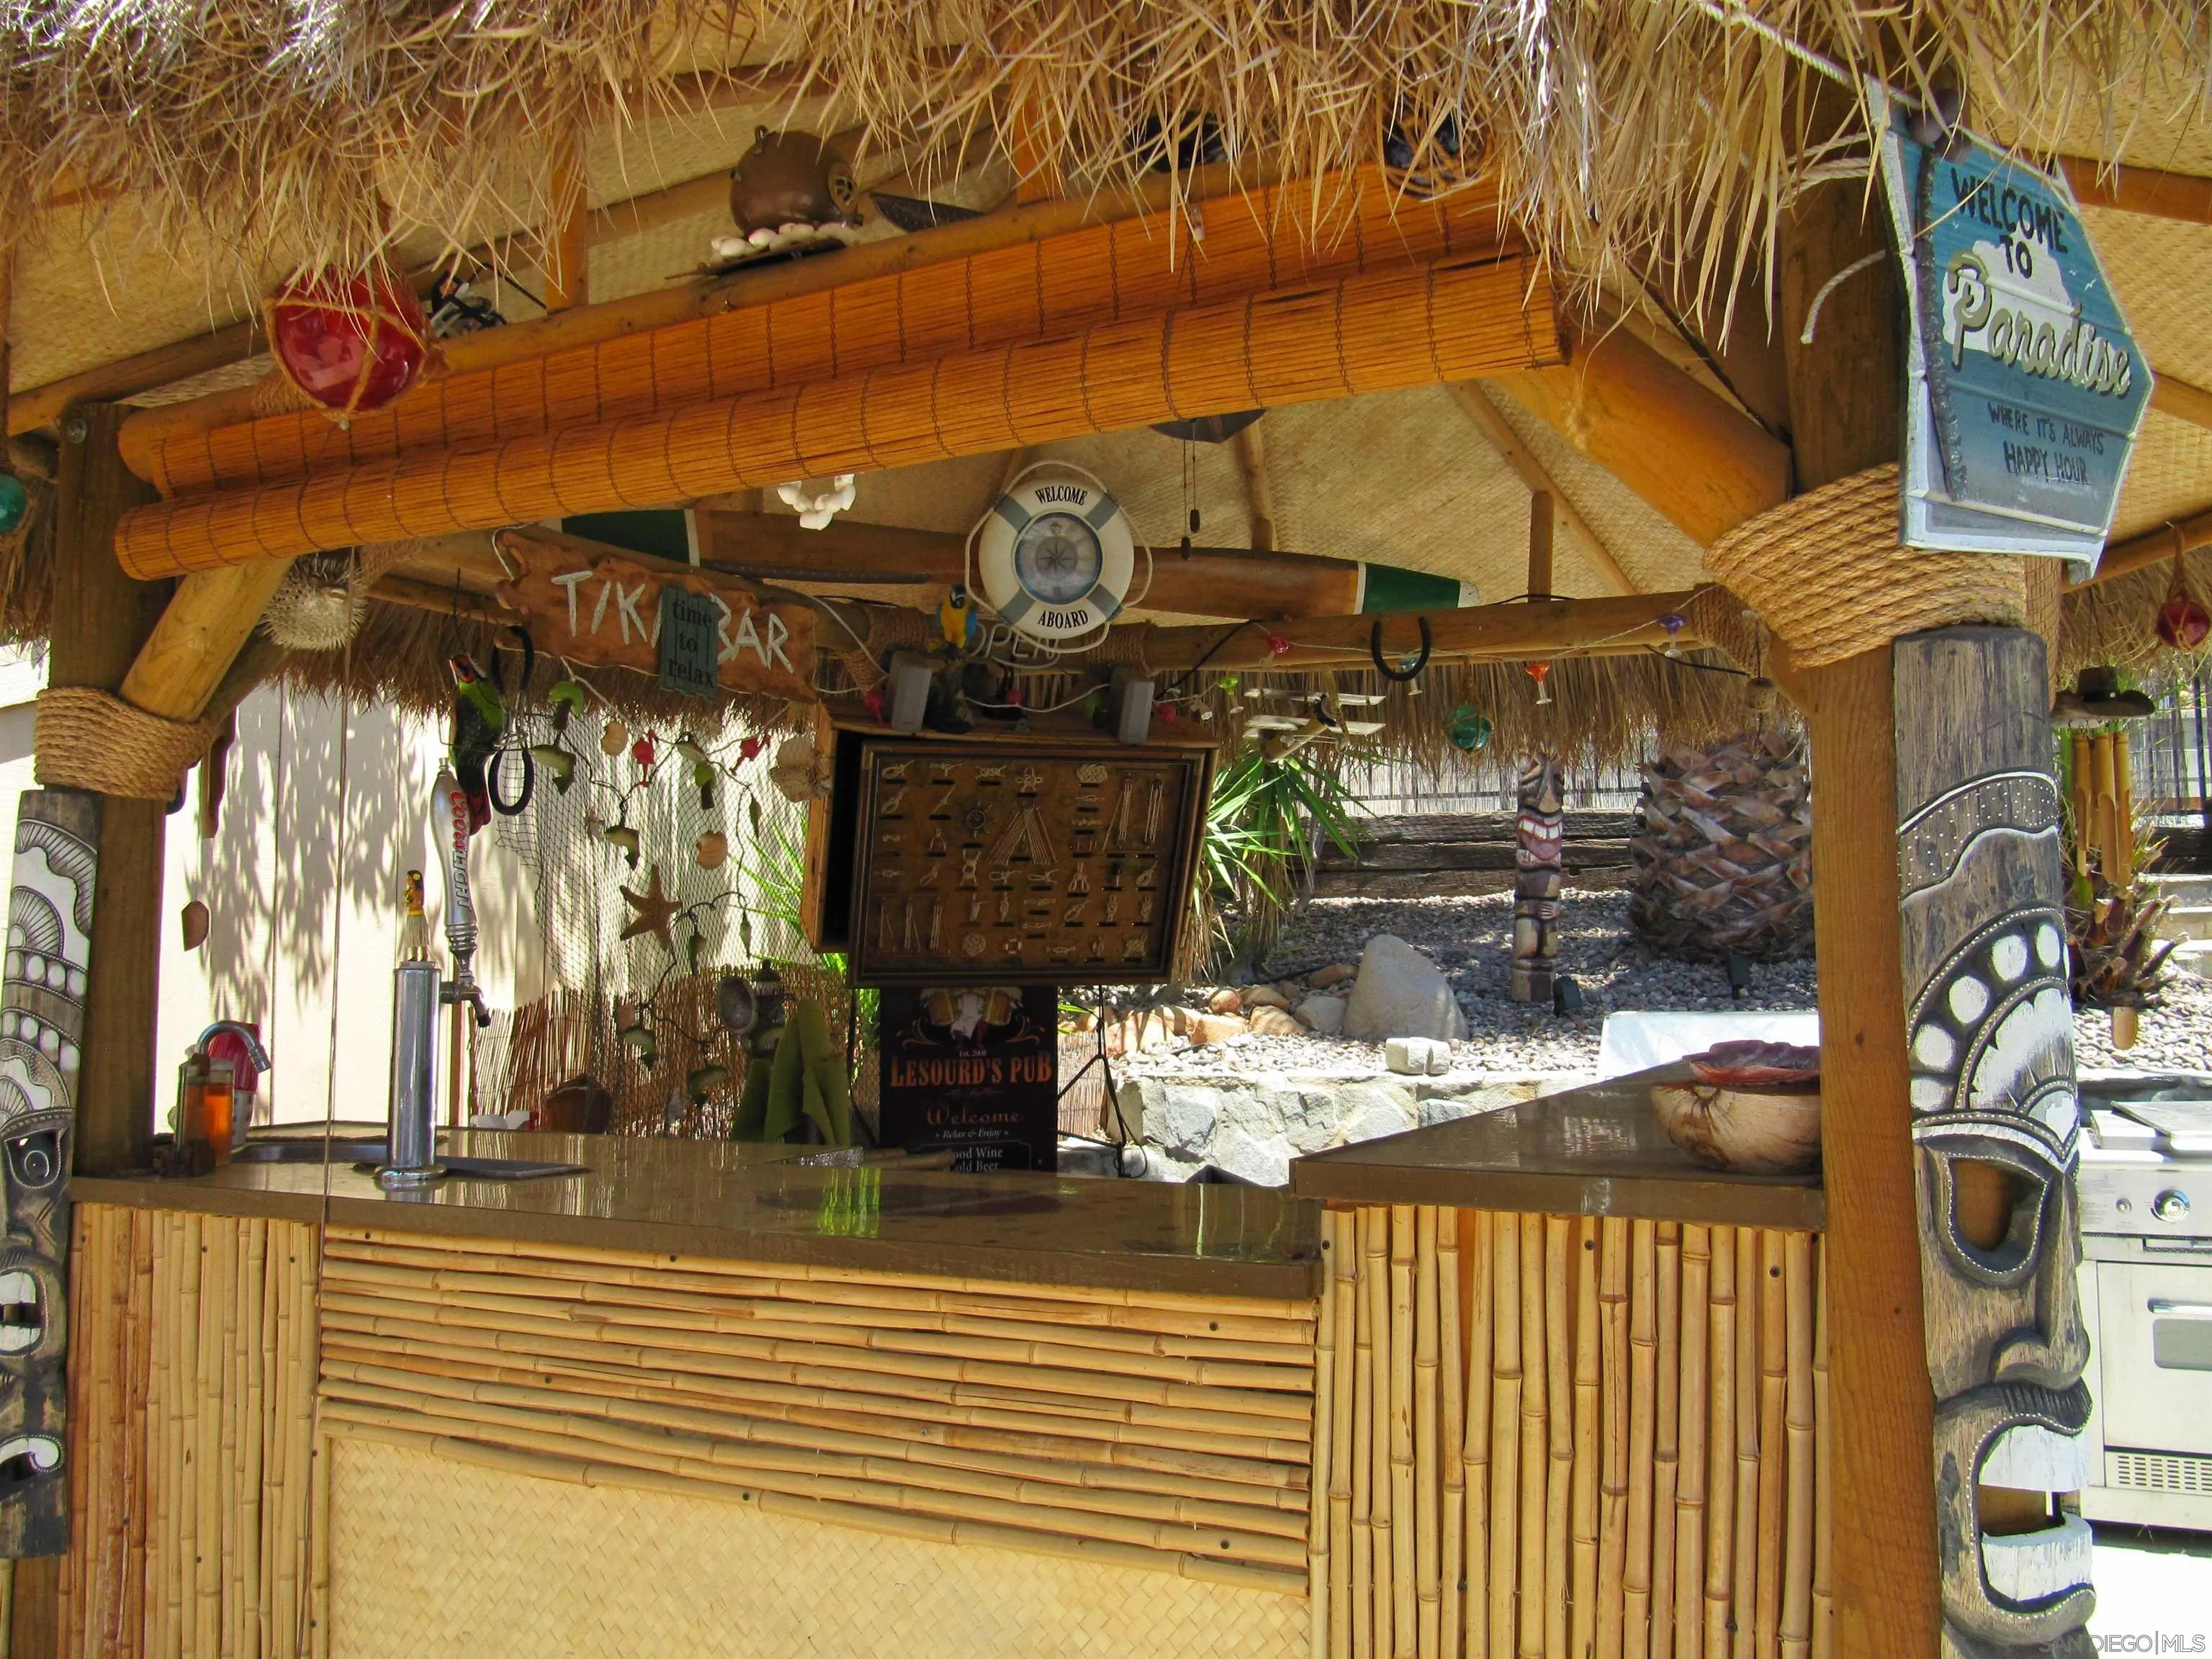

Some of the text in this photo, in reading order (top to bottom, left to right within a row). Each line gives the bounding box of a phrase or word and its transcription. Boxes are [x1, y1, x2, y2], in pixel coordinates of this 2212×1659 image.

[1950, 167, 2068, 254] WELCOME
[1999, 234, 2033, 279] TO
[1947, 250, 2131, 400] Paradise
[1987, 401, 2105, 455] WHERE IT'S ALWAYS
[2002, 439, 2087, 482] HAPPY HOUR
[1035, 486, 1089, 505] WELCOME
[551, 570, 793, 674] TIKI BAR
[673, 599, 712, 626] time
[1038, 609, 1089, 629] ABOARD
[678, 631, 697, 652] to
[667, 657, 715, 688] relax
[452, 850, 472, 912] LIGHT
[1010, 1051, 1052, 1083] PUB
[926, 1102, 1023, 1125] Welcome
[943, 1127, 1002, 1139] Relax & Enjoy
[955, 1146, 1003, 1159] ood Wine
[976, 1160, 999, 1172] Beer
